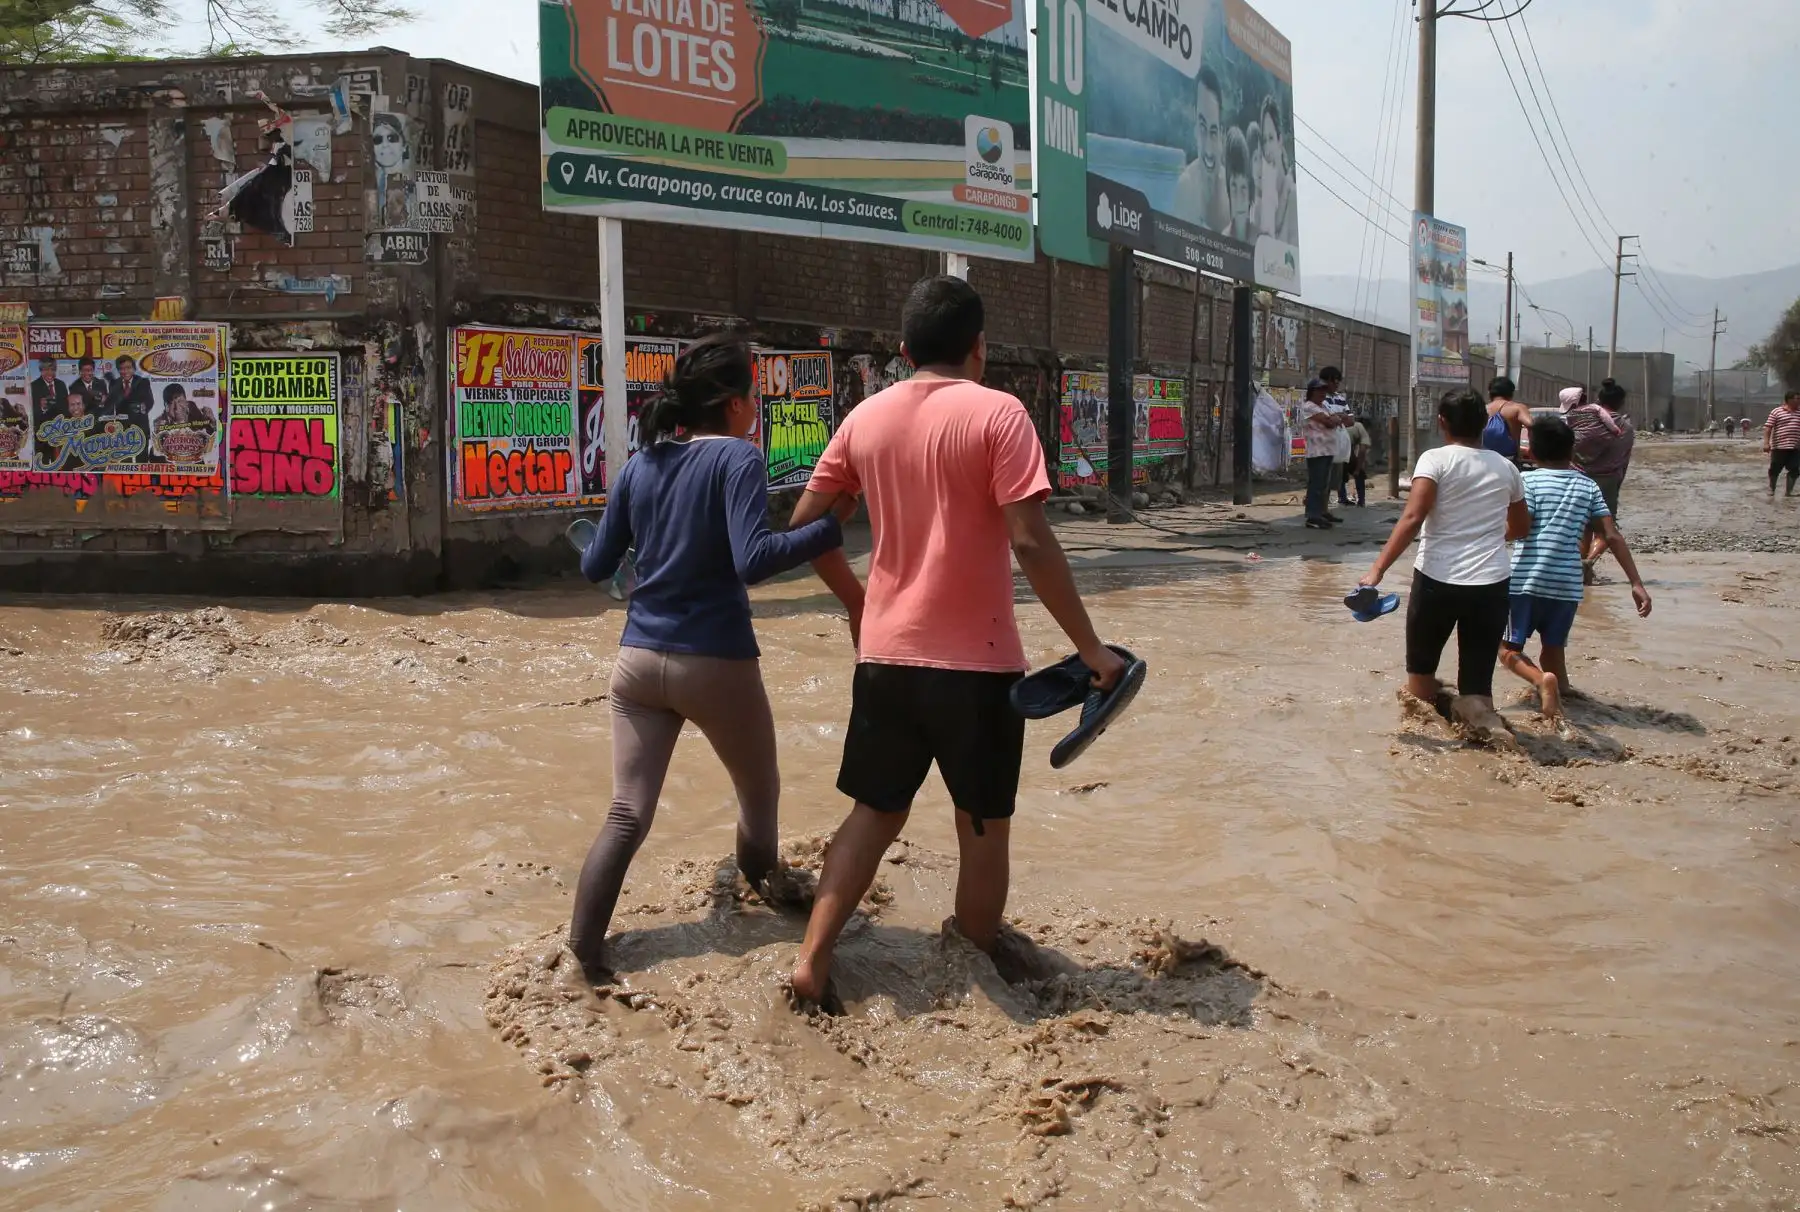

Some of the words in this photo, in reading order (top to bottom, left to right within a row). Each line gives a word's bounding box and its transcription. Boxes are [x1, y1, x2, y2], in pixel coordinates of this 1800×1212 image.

[701, 0, 735, 37] DE
[1123, 0, 1193, 60] CAMPO
[606, 16, 736, 92] LOTES
[1044, 0, 1083, 96] 10
[1045, 95, 1084, 160] MIN.
[566, 118, 667, 151] APROVECHA
[671, 133, 691, 156] LA
[695, 137, 725, 161] PRE
[728, 141, 775, 167] VENTA
[415, 171, 448, 184] PINTOR
[969, 165, 1013, 185] Carapongo
[427, 185, 440, 197] DE
[584, 163, 613, 185] Av.
[616, 167, 718, 201] Carapongo,
[720, 185, 763, 204] cruce
[765, 190, 793, 207] con
[795, 190, 818, 210] Av.
[821, 194, 845, 214] Los
[847, 197, 898, 221] Sauces.
[965, 188, 1017, 209] CARAPONGO
[418, 201, 451, 218] CASAS
[967, 217, 1023, 242] 748-4000
[385, 235, 423, 251] ABRIL
[29, 328, 65, 343] SAB.
[65, 327, 102, 358] 01
[533, 337, 569, 347] RESTO-BAR
[29, 343, 64, 353] ABRIL
[462, 332, 504, 386] 17
[504, 336, 569, 380] Salonazo
[638, 343, 673, 353] RESTO-BAR
[231, 360, 327, 377] COMPLEJO
[766, 355, 788, 396] 19
[464, 387, 508, 401] VIERNES
[510, 388, 571, 402] TROPICALES
[235, 404, 276, 415] ANTIGUO
[278, 404, 285, 414] Y
[286, 404, 334, 415] MODERNO
[462, 401, 513, 438] DEYVIS
[515, 401, 571, 437] OROSCO
[771, 404, 782, 423] EL
[512, 437, 517, 448] Y
[517, 437, 527, 448] SU
[536, 437, 570, 447] GRUPO
[768, 417, 830, 464] NAVARRO
[107, 464, 139, 472] MUJERES
[140, 464, 176, 473] GRATIS
[230, 450, 335, 495] SINO
[462, 438, 572, 500] Nectar
